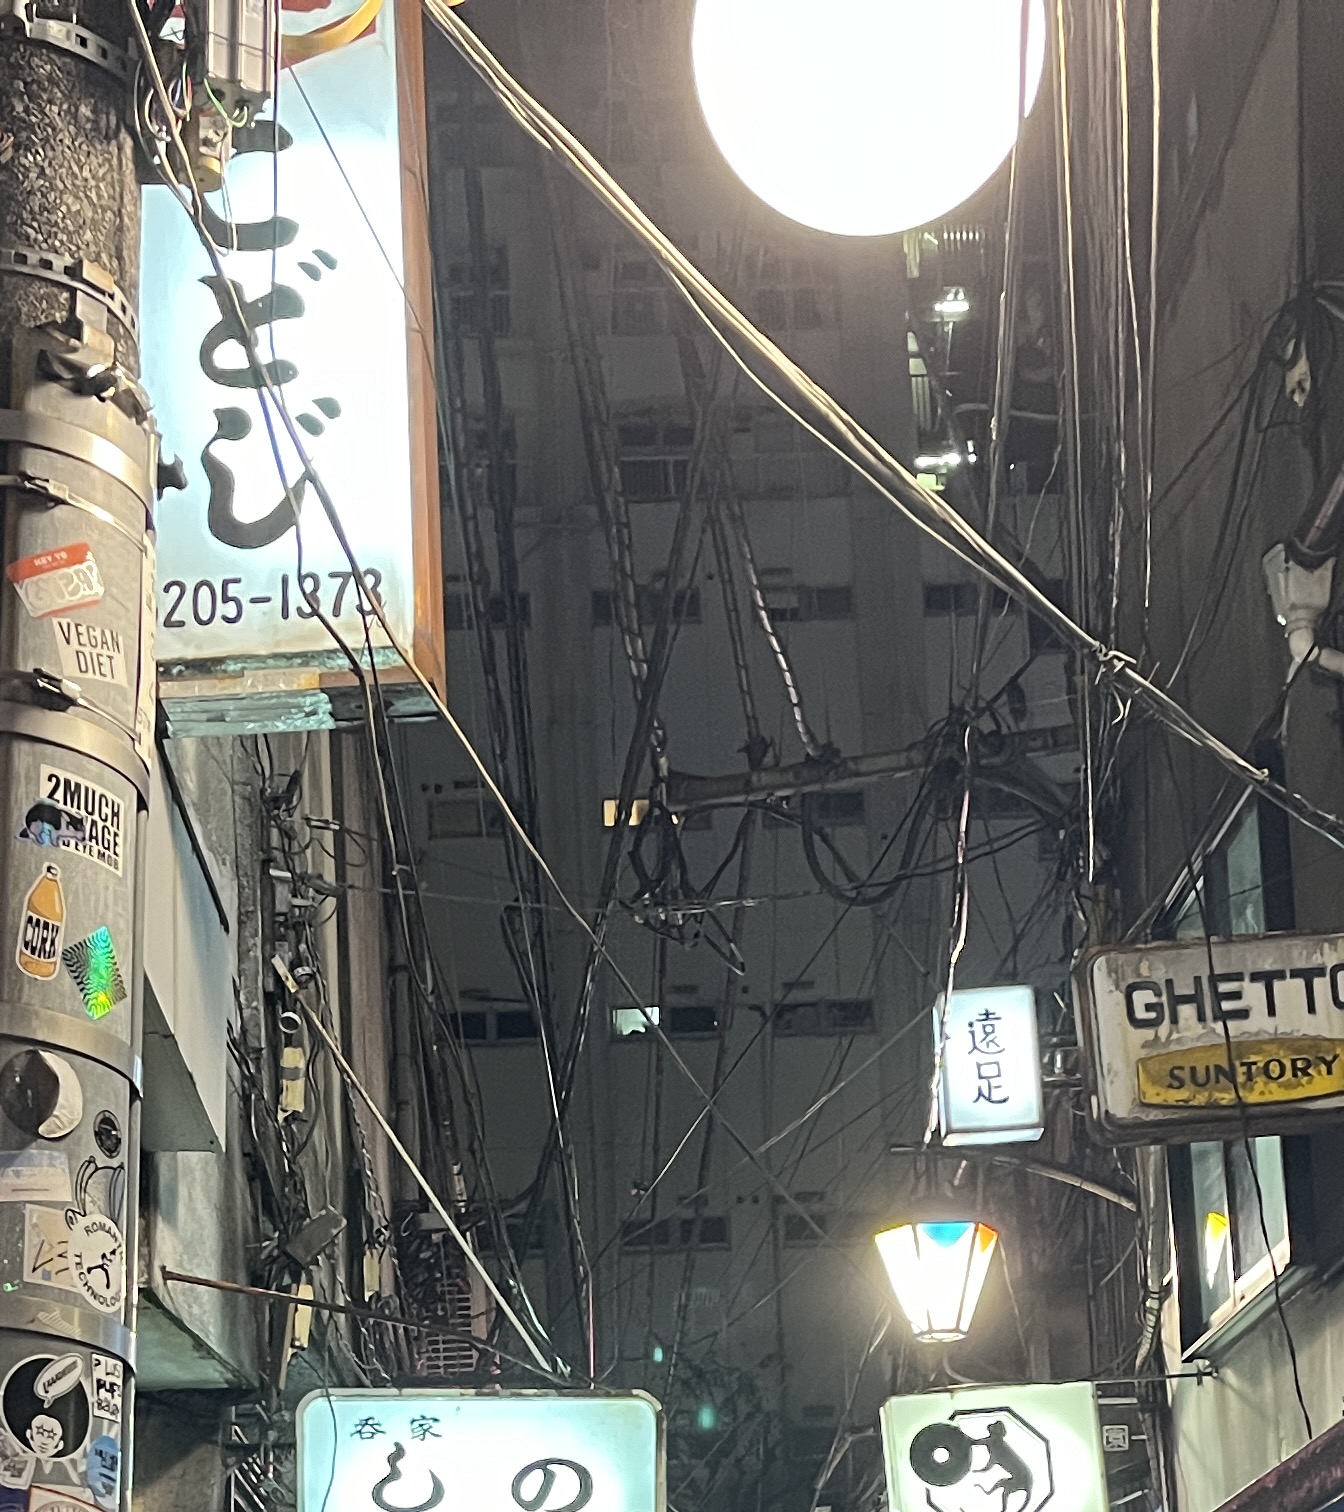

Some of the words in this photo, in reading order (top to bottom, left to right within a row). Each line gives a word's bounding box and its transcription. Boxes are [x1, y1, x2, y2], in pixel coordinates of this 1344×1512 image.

[57, 620, 121, 654] VEGAN
[75, 650, 115, 680] DIET
[47, 773, 121, 832] 2MUCH
[968, 1008, 1009, 1104] 遠足
[1166, 1053, 1340, 1090] SUNTORY
